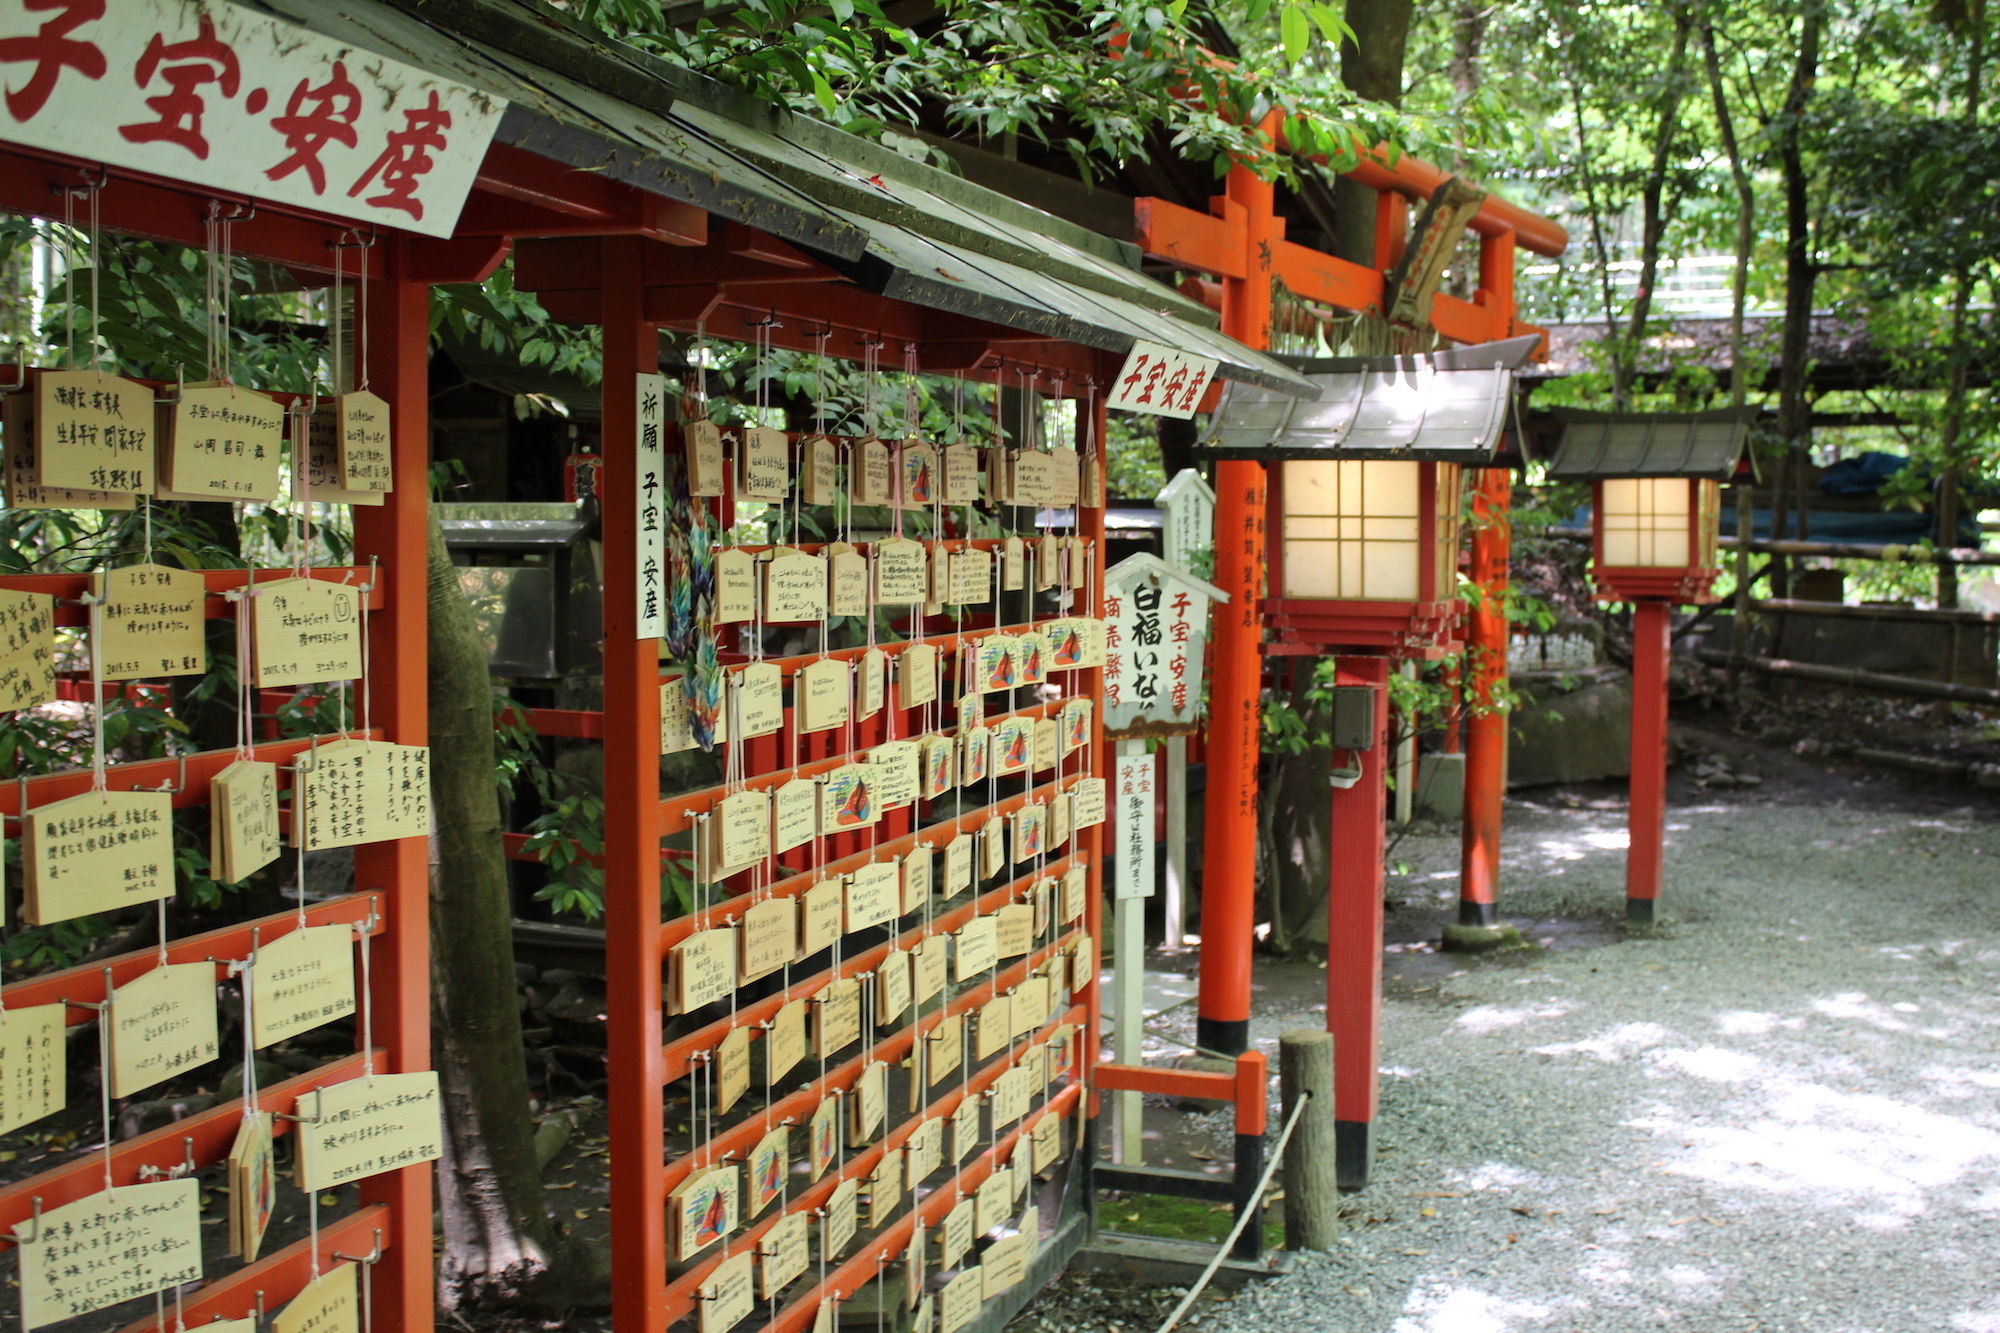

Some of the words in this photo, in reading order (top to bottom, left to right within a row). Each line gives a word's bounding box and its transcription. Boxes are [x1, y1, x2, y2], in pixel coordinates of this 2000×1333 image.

[0, 0, 452, 222] 子宝・安産
[641, 391, 659, 454] 祈願
[1120, 354, 1207, 411] 子宝・安産
[1169, 592, 1192, 708] 子宝・安産
